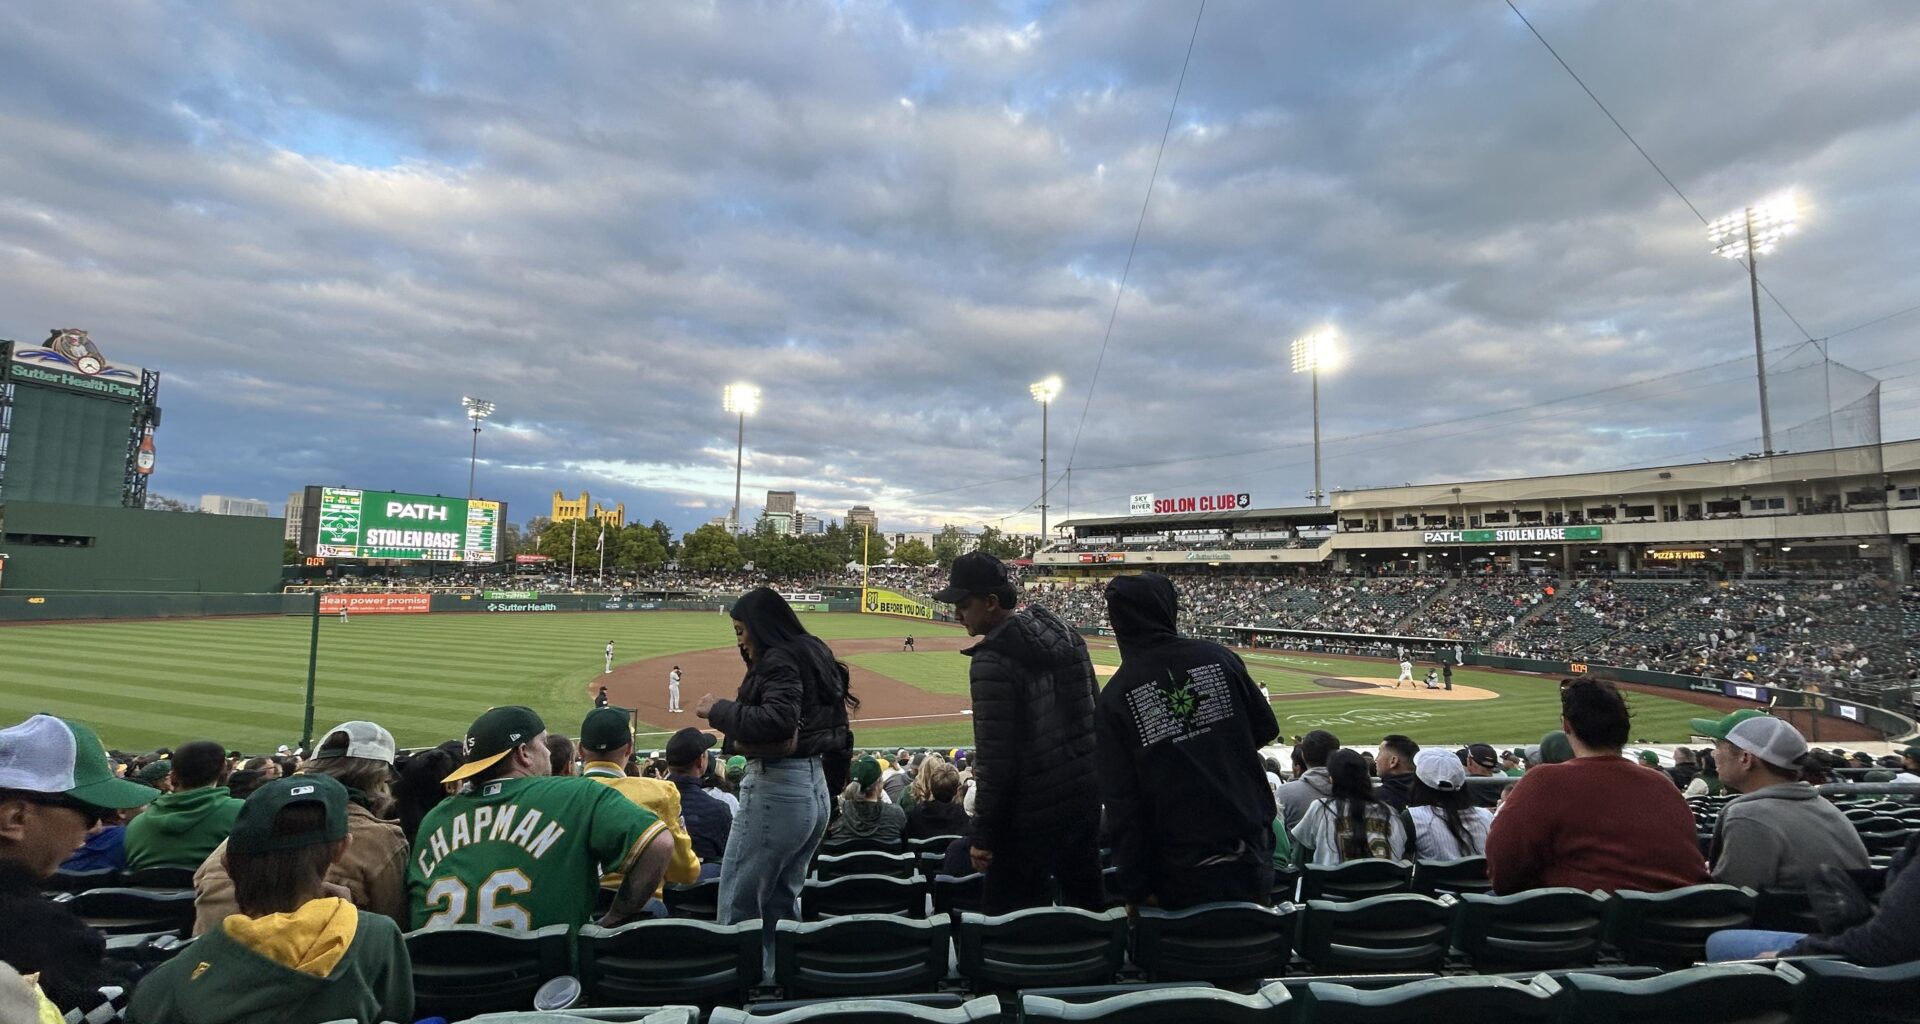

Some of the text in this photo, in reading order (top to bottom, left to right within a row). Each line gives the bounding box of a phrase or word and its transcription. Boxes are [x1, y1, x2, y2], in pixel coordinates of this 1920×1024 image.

[12, 365, 140, 397] Sutter Health Park
[1154, 497, 1196, 513] SOLON
[1199, 494, 1236, 511] CLUB
[366, 529, 461, 548] STOLEN BASE
[1496, 529, 1536, 541] STOLEN
[1536, 528, 1566, 540] BASE
[1683, 551, 1706, 559] PINTS
[350, 597, 383, 606] power
[386, 596, 428, 606] promise
[498, 603, 557, 611] Sutter Health
[880, 602, 926, 616] BEFORE YOU DIG
[418, 804, 566, 879] CHAPMAN
[424, 867, 532, 934] 26
